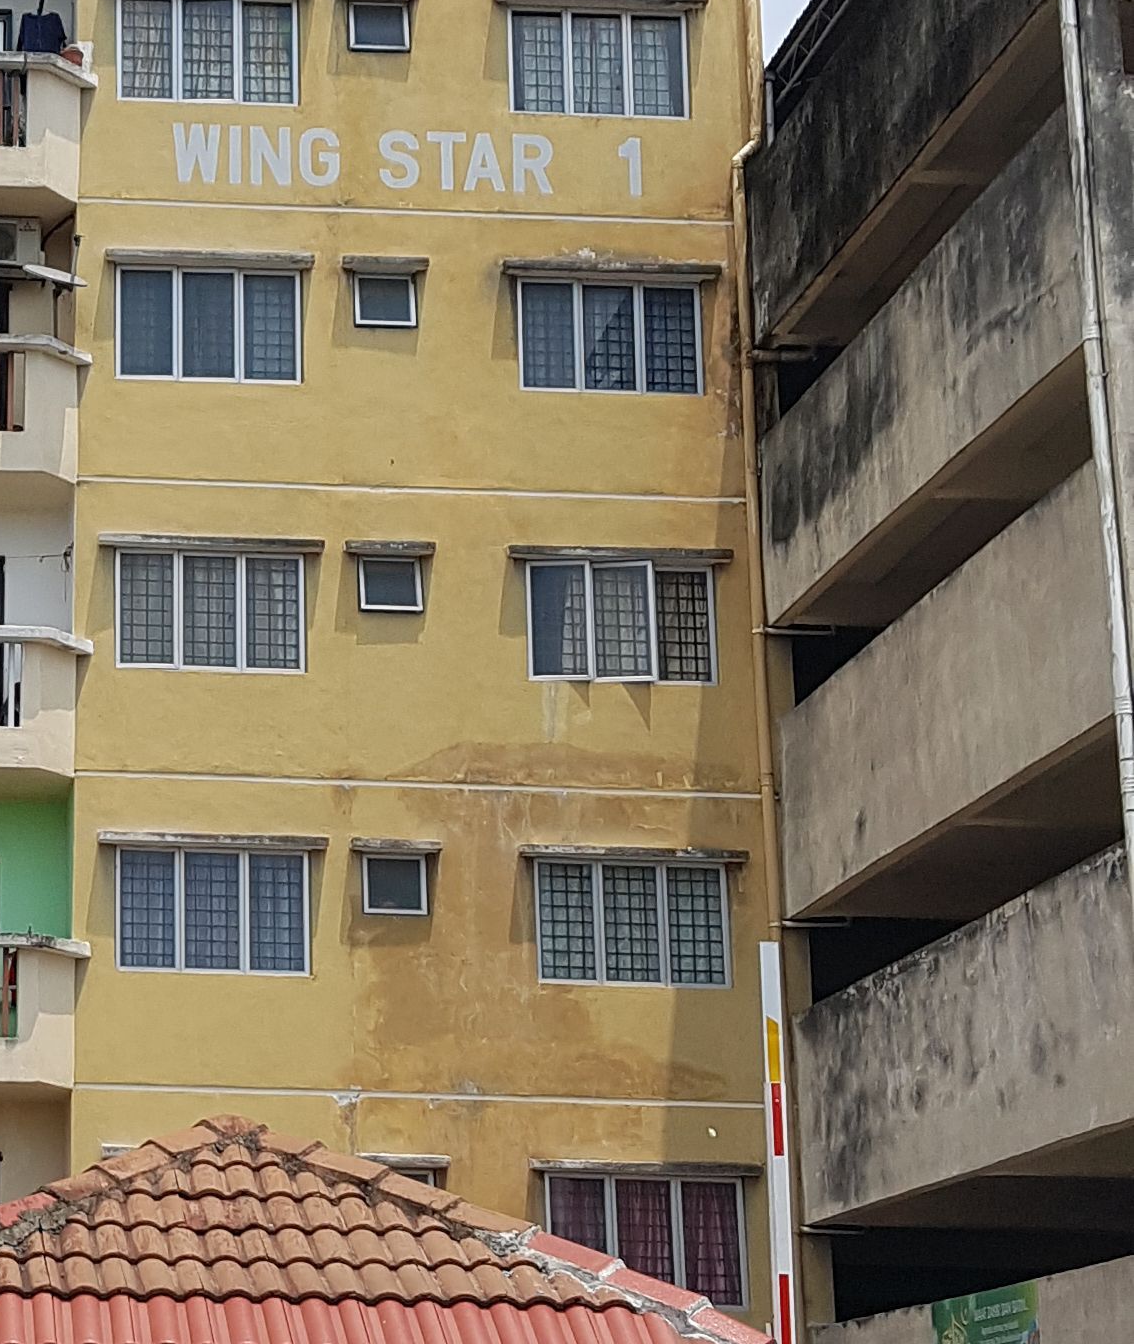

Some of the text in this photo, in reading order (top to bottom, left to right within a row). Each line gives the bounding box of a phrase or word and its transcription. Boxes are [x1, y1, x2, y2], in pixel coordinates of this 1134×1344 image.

[172, 122, 642, 197] WING STAR 1
